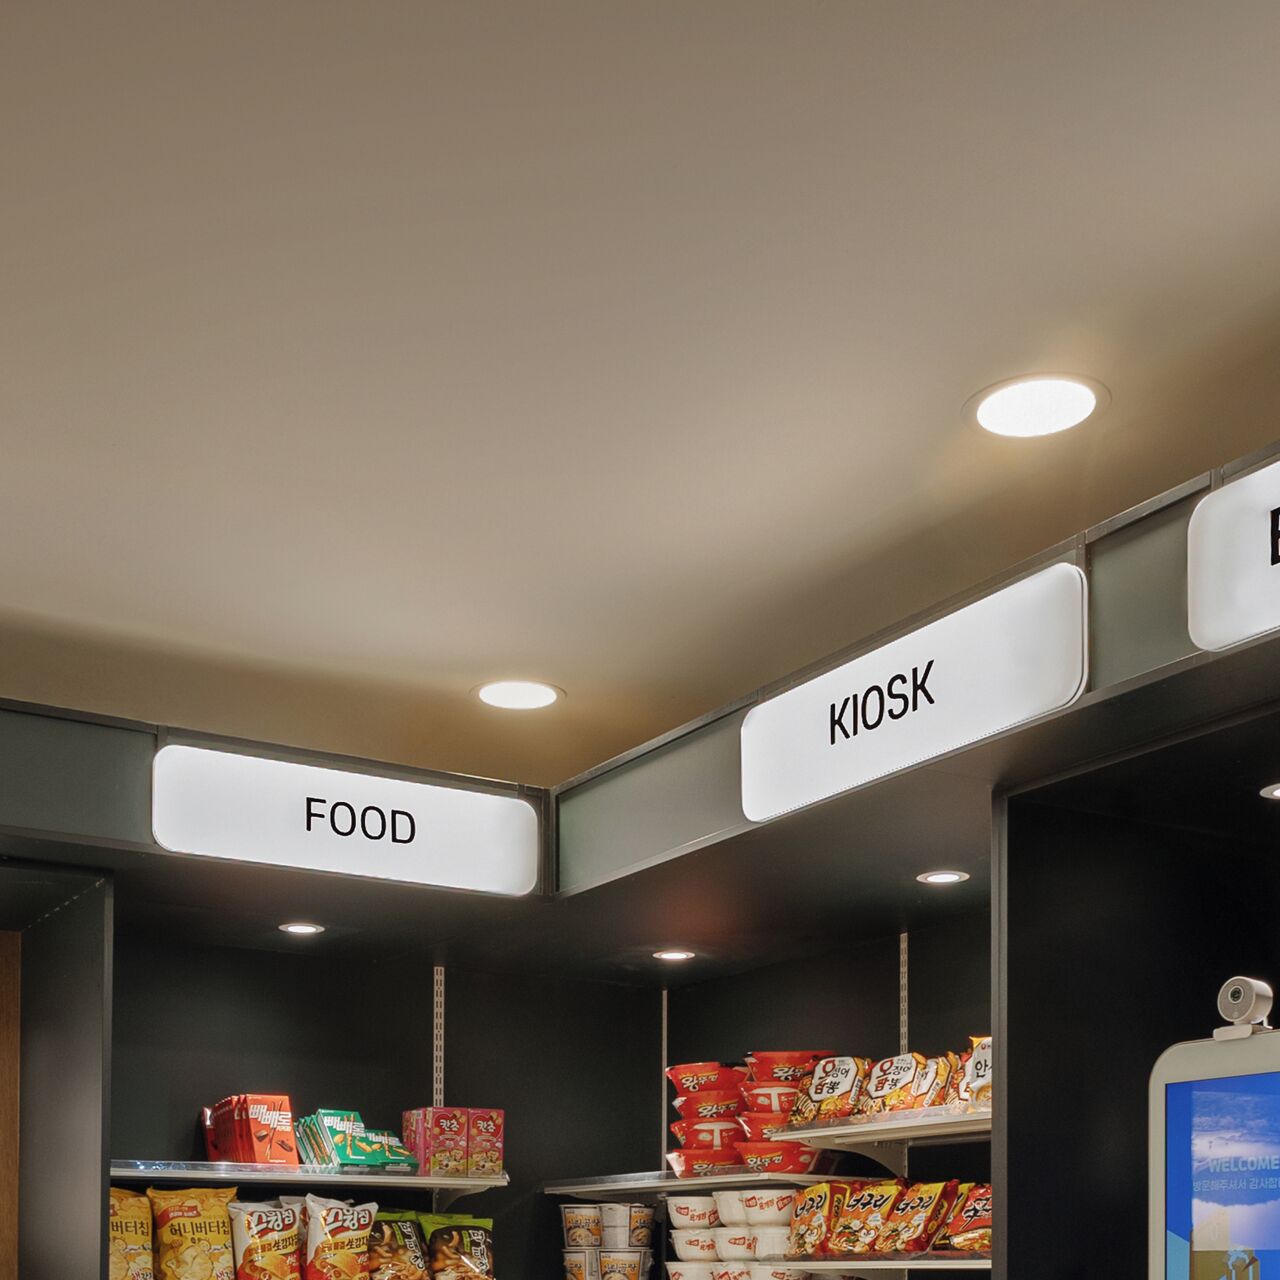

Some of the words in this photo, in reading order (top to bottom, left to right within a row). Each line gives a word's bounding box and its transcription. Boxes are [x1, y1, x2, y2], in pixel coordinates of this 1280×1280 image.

[827, 660, 936, 746] KIOSK
[305, 797, 418, 846] FOOD
[248, 1104, 292, 1129] 빼빼로
[439, 1119, 460, 1132] 칸쵸
[477, 1120, 496, 1133] 칸쵸
[1208, 1155, 1280, 1173] WELCOME
[846, 1192, 892, 1213] 너구리
[111, 1220, 150, 1237] 버터칩
[168, 1220, 230, 1237] 허니버터칩
